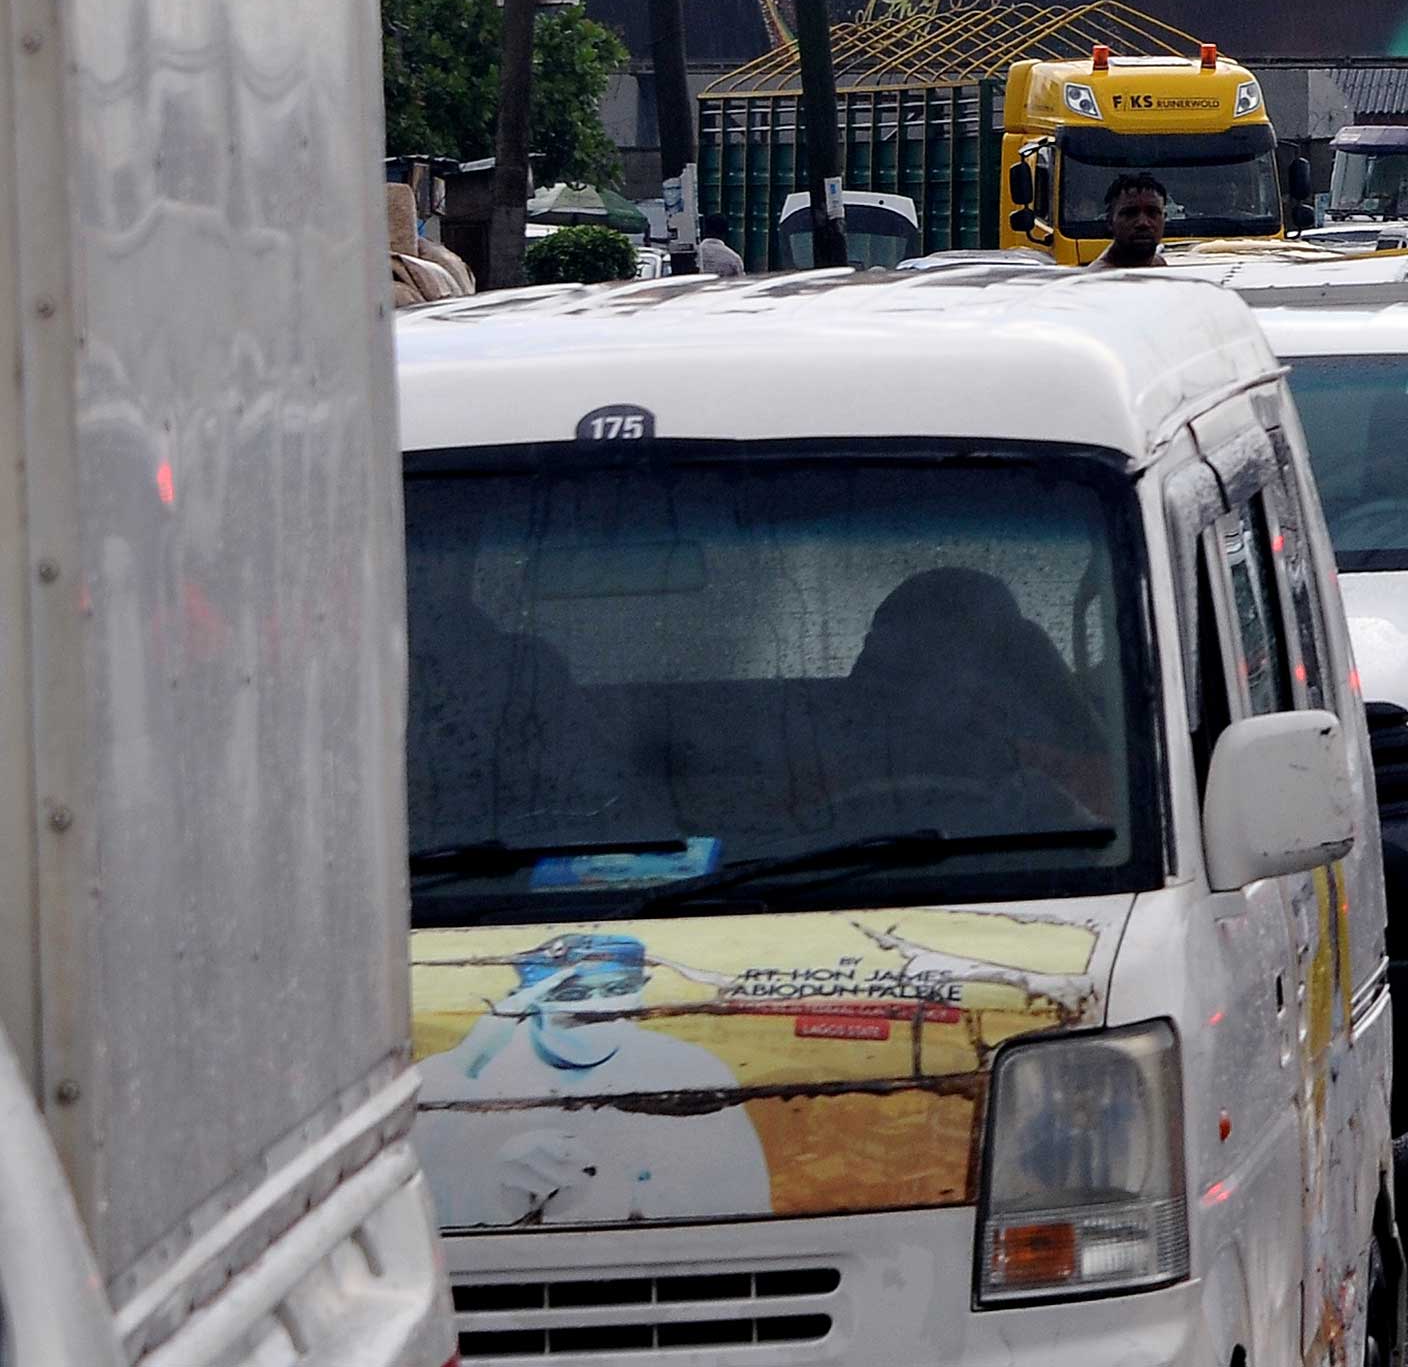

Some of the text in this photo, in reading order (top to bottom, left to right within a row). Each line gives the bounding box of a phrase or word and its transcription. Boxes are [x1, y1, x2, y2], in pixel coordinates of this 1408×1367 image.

[590, 414, 644, 440] 175
[838, 957, 862, 966] BY
[864, 970, 953, 982] JAMES
[731, 984, 857, 997] ABIODUN
